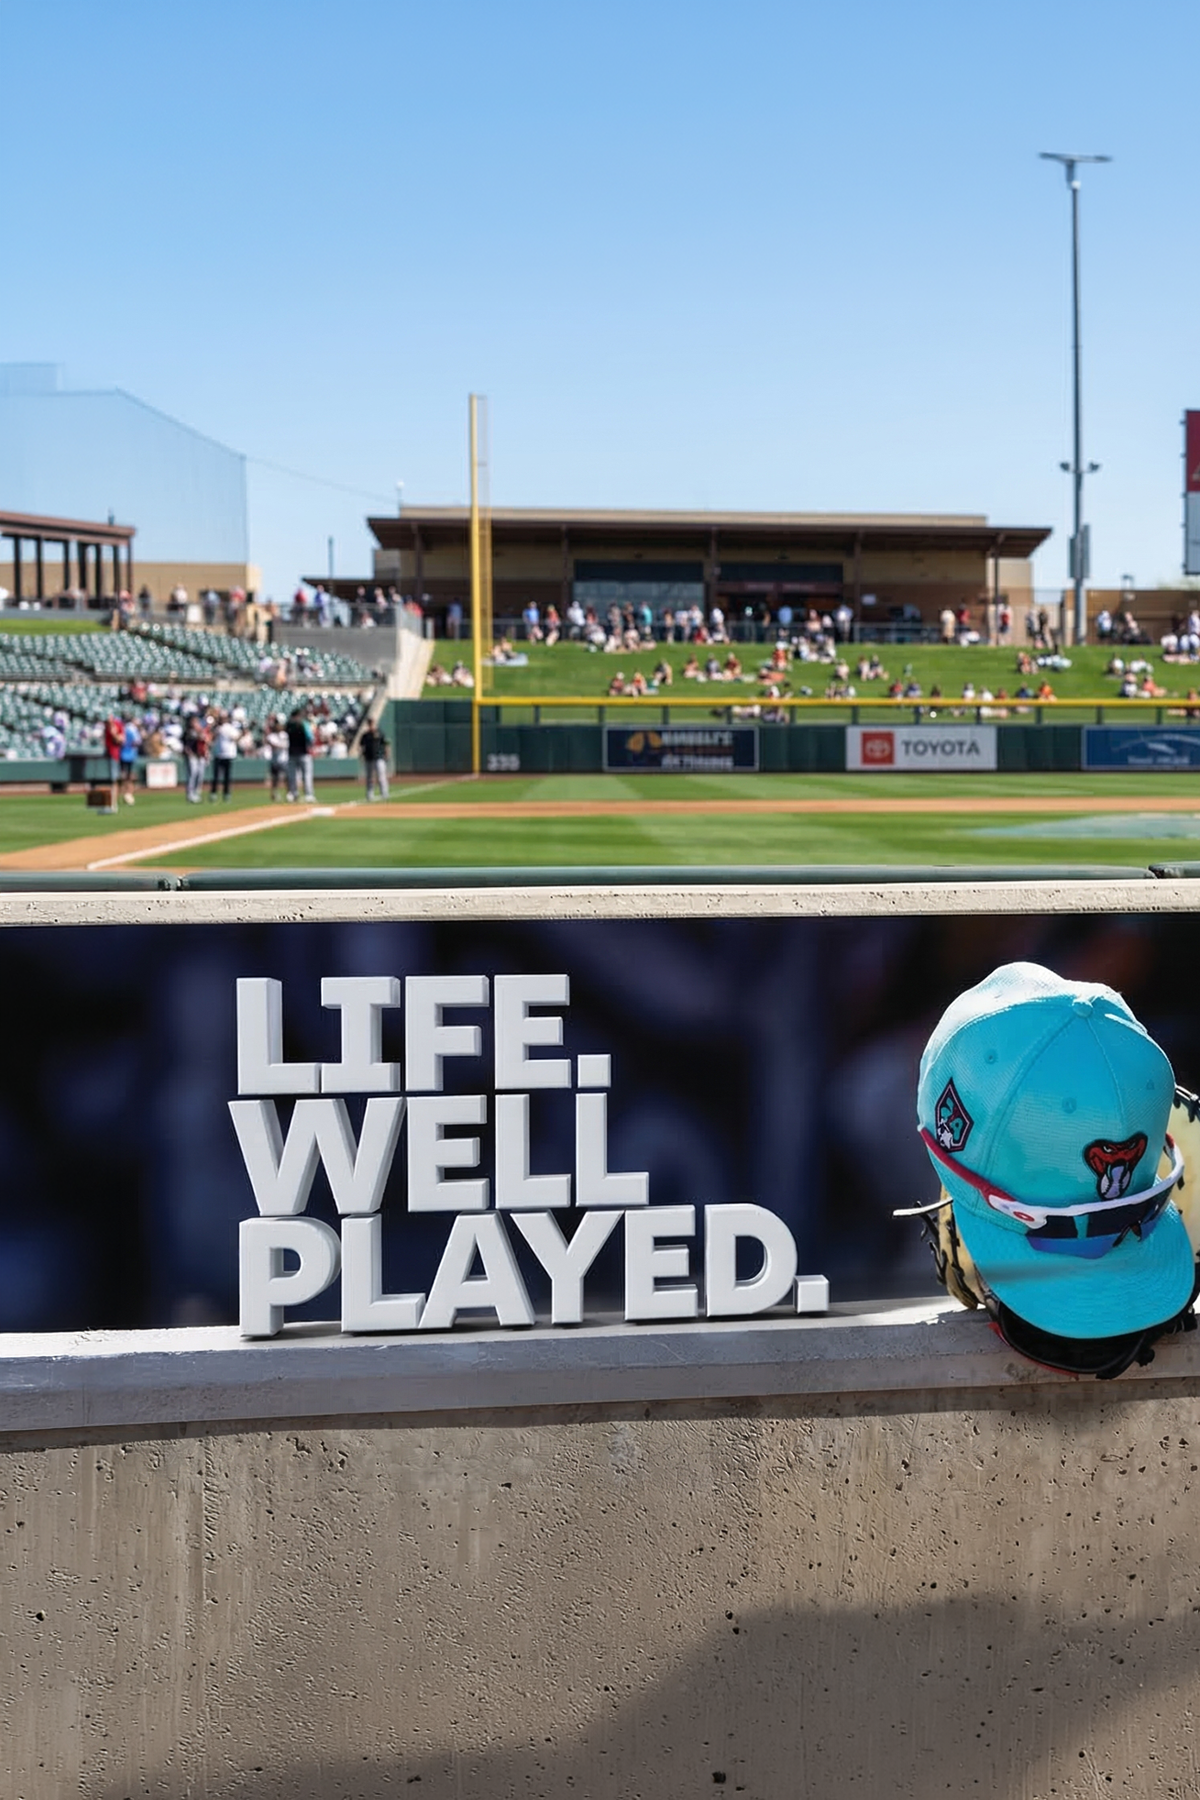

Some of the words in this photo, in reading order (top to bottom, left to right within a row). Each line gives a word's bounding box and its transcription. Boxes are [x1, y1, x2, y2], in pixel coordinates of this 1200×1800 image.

[902, 739, 981, 757] TOYOTA
[236, 974, 611, 1095] LIFE.
[228, 1092, 649, 1216] WELL
[239, 1204, 829, 1337] PLAYED.
